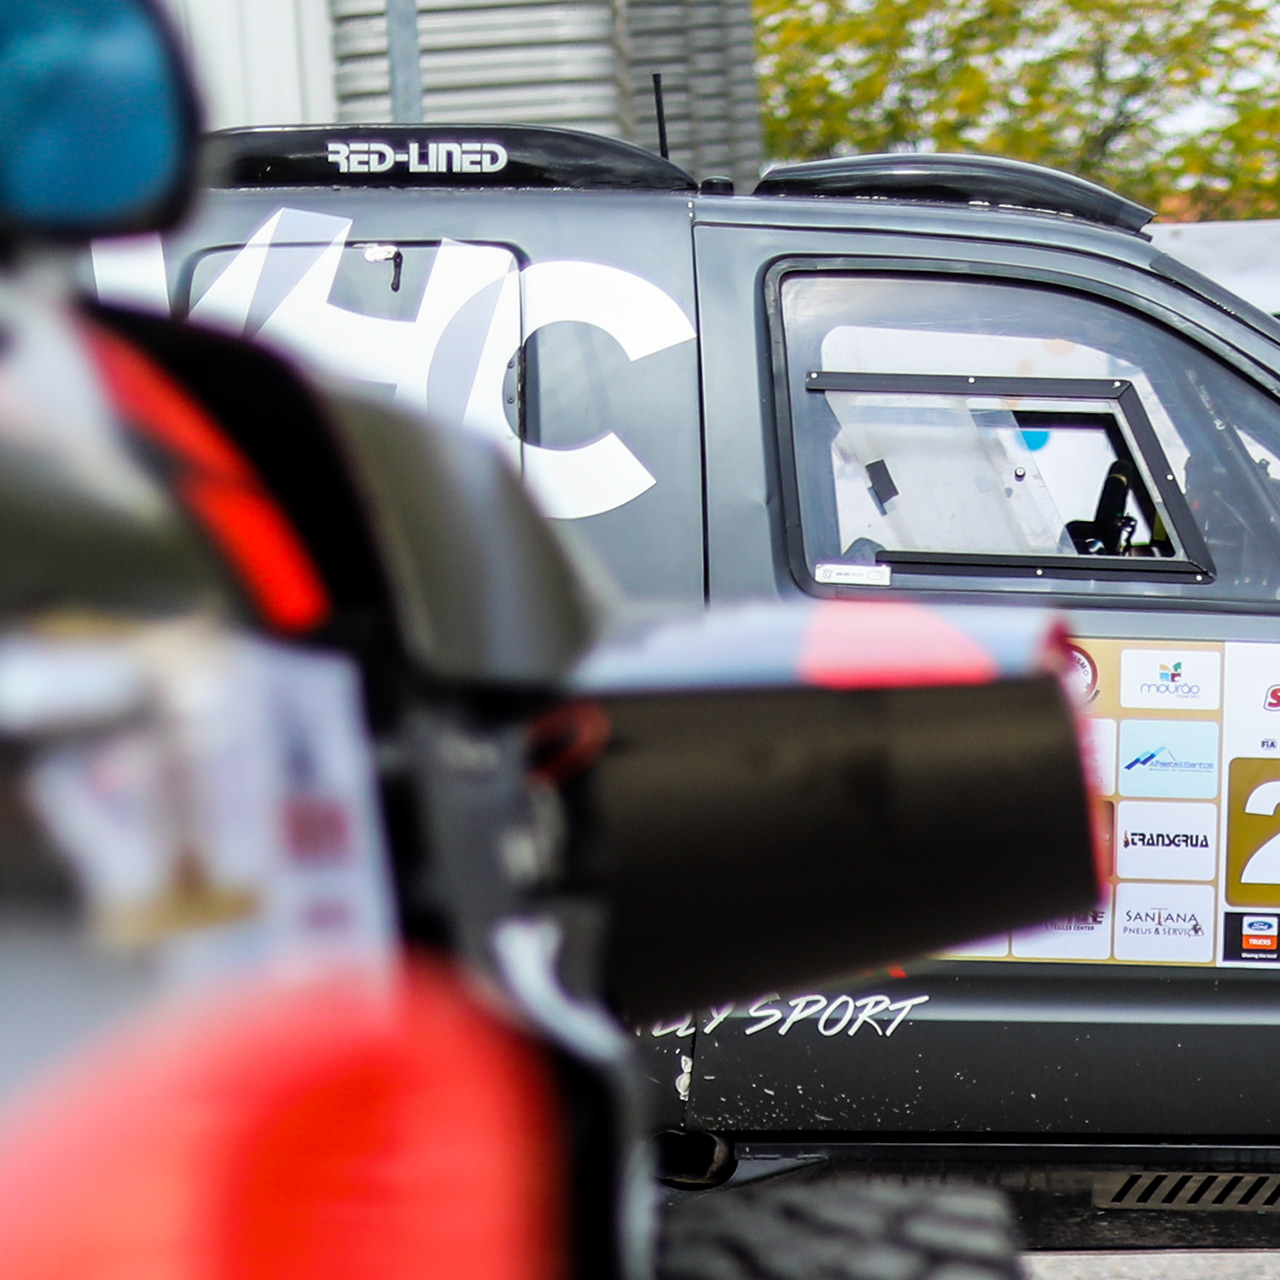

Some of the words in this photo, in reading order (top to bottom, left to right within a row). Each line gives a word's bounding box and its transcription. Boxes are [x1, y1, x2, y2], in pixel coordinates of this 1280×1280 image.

[327, 142, 508, 173] RED-LINED
[1261, 740, 1276, 748] FIA
[1126, 909, 1199, 927] SANTANA
[1123, 926, 1152, 935] PNEUS
[1251, 922, 1269, 930] Ford
[745, 995, 929, 1037] SPORT
